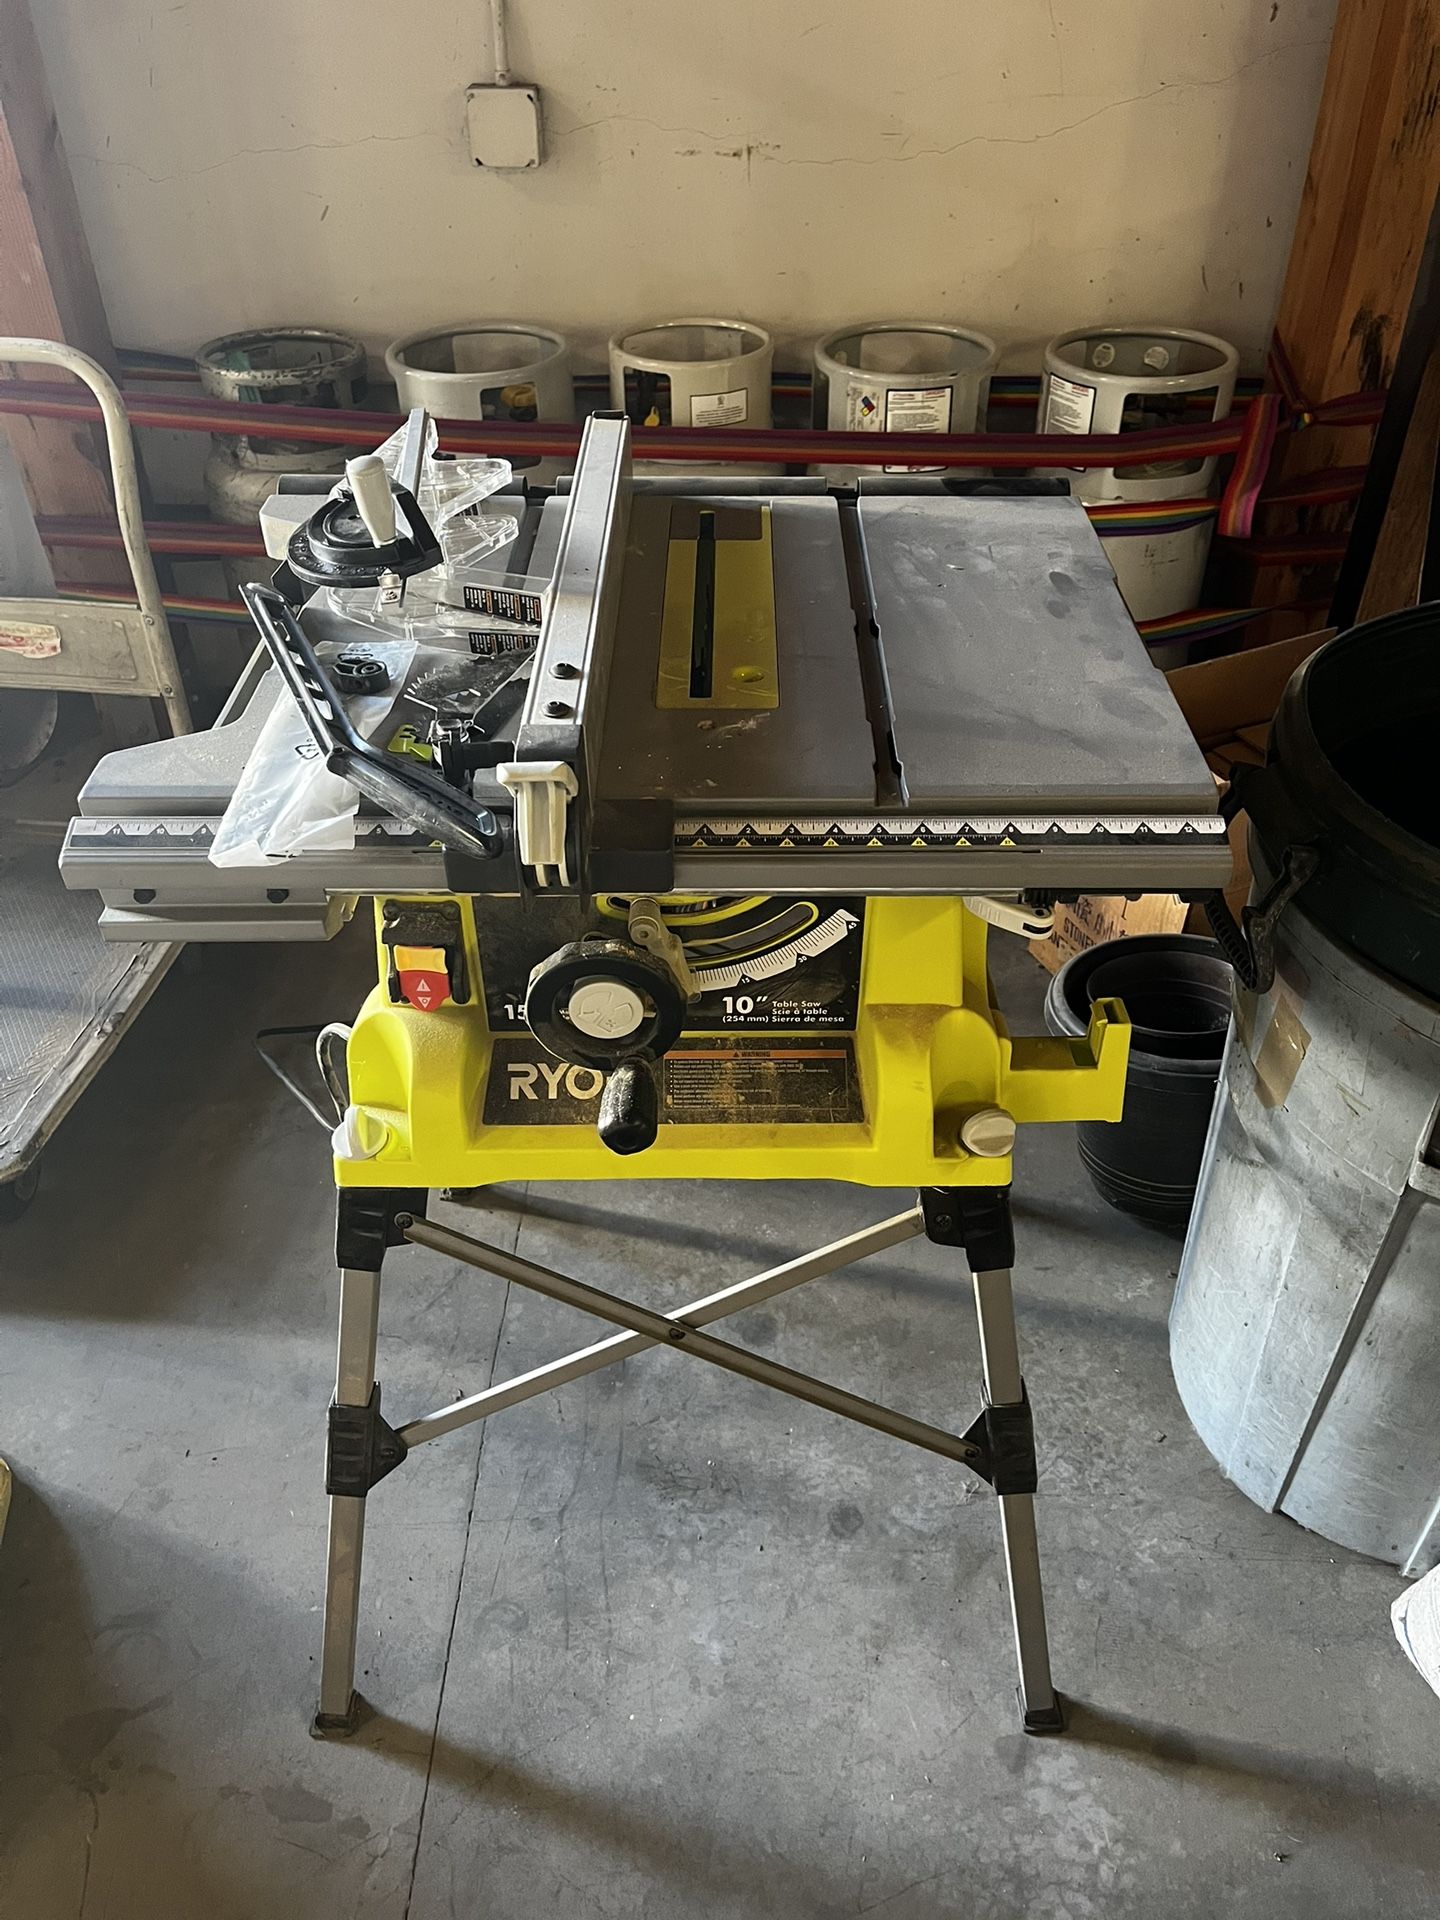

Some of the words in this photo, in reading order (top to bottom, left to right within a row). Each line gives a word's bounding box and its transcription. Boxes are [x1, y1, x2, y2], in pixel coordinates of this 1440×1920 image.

[848, 922, 857, 930] 45
[798, 955, 808, 963] 30
[772, 1000, 798, 1008] Table
[801, 1000, 821, 1008] Saw
[722, 1015, 744, 1023] (254
[747, 1015, 769, 1023] mm)
[772, 1015, 801, 1023] Sierra
[507, 1063, 608, 1100] RYO
